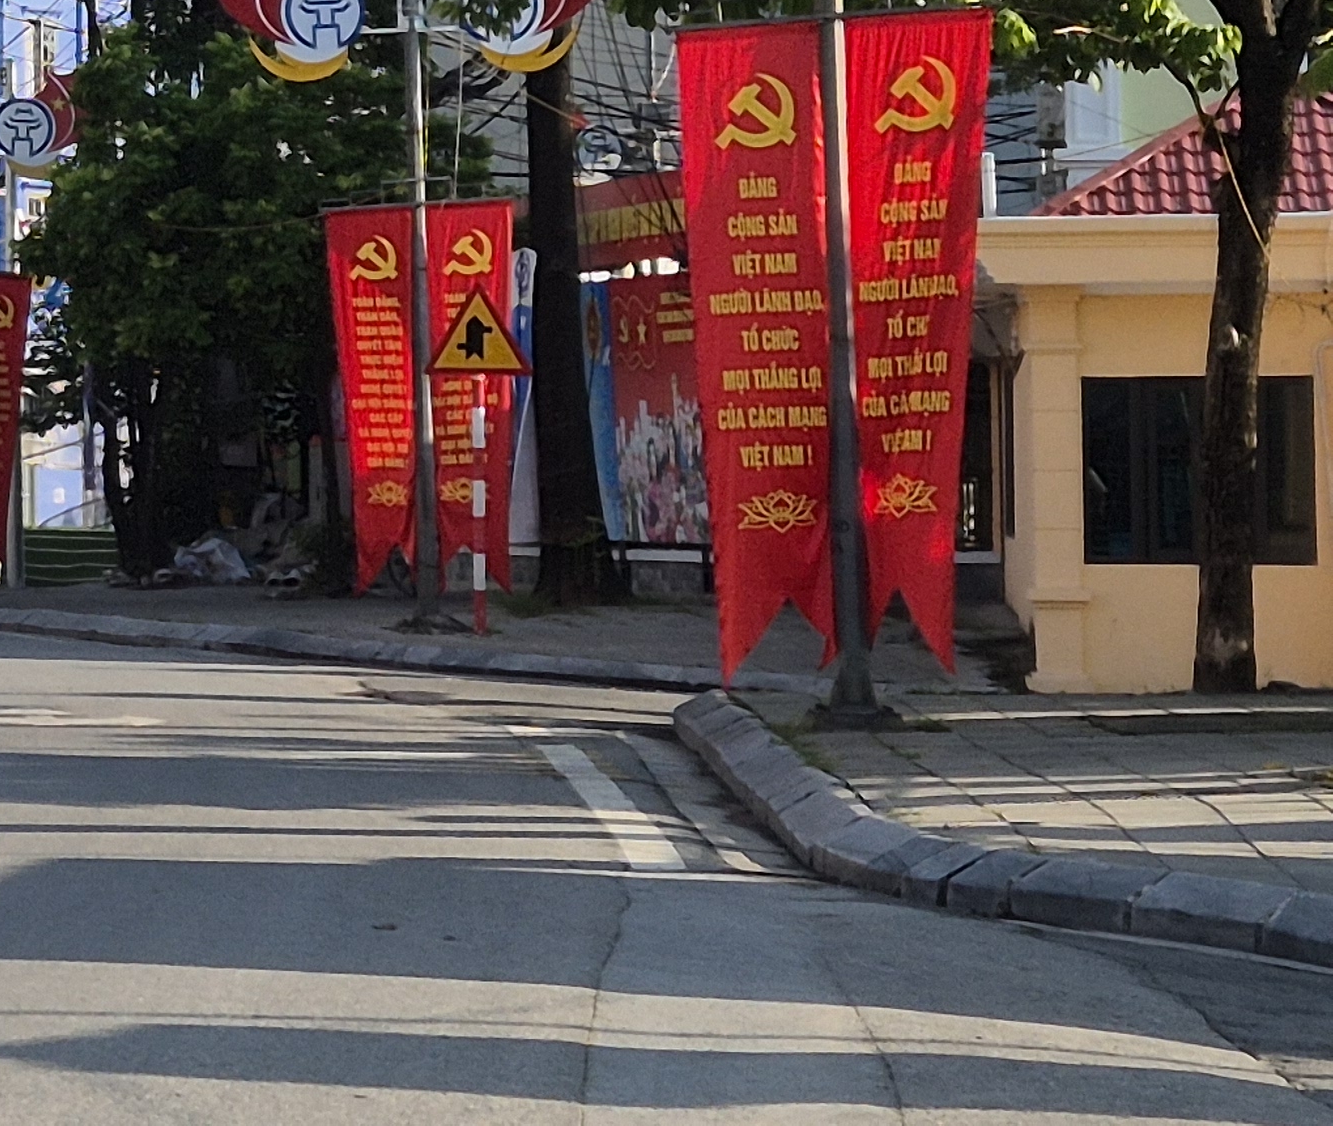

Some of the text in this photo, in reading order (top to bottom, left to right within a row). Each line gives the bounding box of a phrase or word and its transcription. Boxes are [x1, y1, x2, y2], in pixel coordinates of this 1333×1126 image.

[738, 171, 778, 199] ĐẢNG
[727, 208, 798, 241] CỘNG SẢN
[880, 197, 917, 228] CỘNG
[732, 249, 797, 279] VIỆT NAM
[883, 235, 912, 266] VIỆT
[709, 287, 752, 314] NGƯỜI
[754, 287, 792, 313] LÃNH
[859, 275, 899, 302] NGƯỜI
[741, 322, 800, 352] TỔ CHỨC
[722, 360, 822, 395] MỌI THẮNG LỢI
[867, 357, 893, 383] MỌI
[925, 349, 948, 377] LỢI
[718, 401, 827, 432] CỦA CÁCH MẠNG
[862, 389, 887, 417] CỦA
[739, 441, 770, 472] VIỆT
[773, 444, 804, 466] NAM
